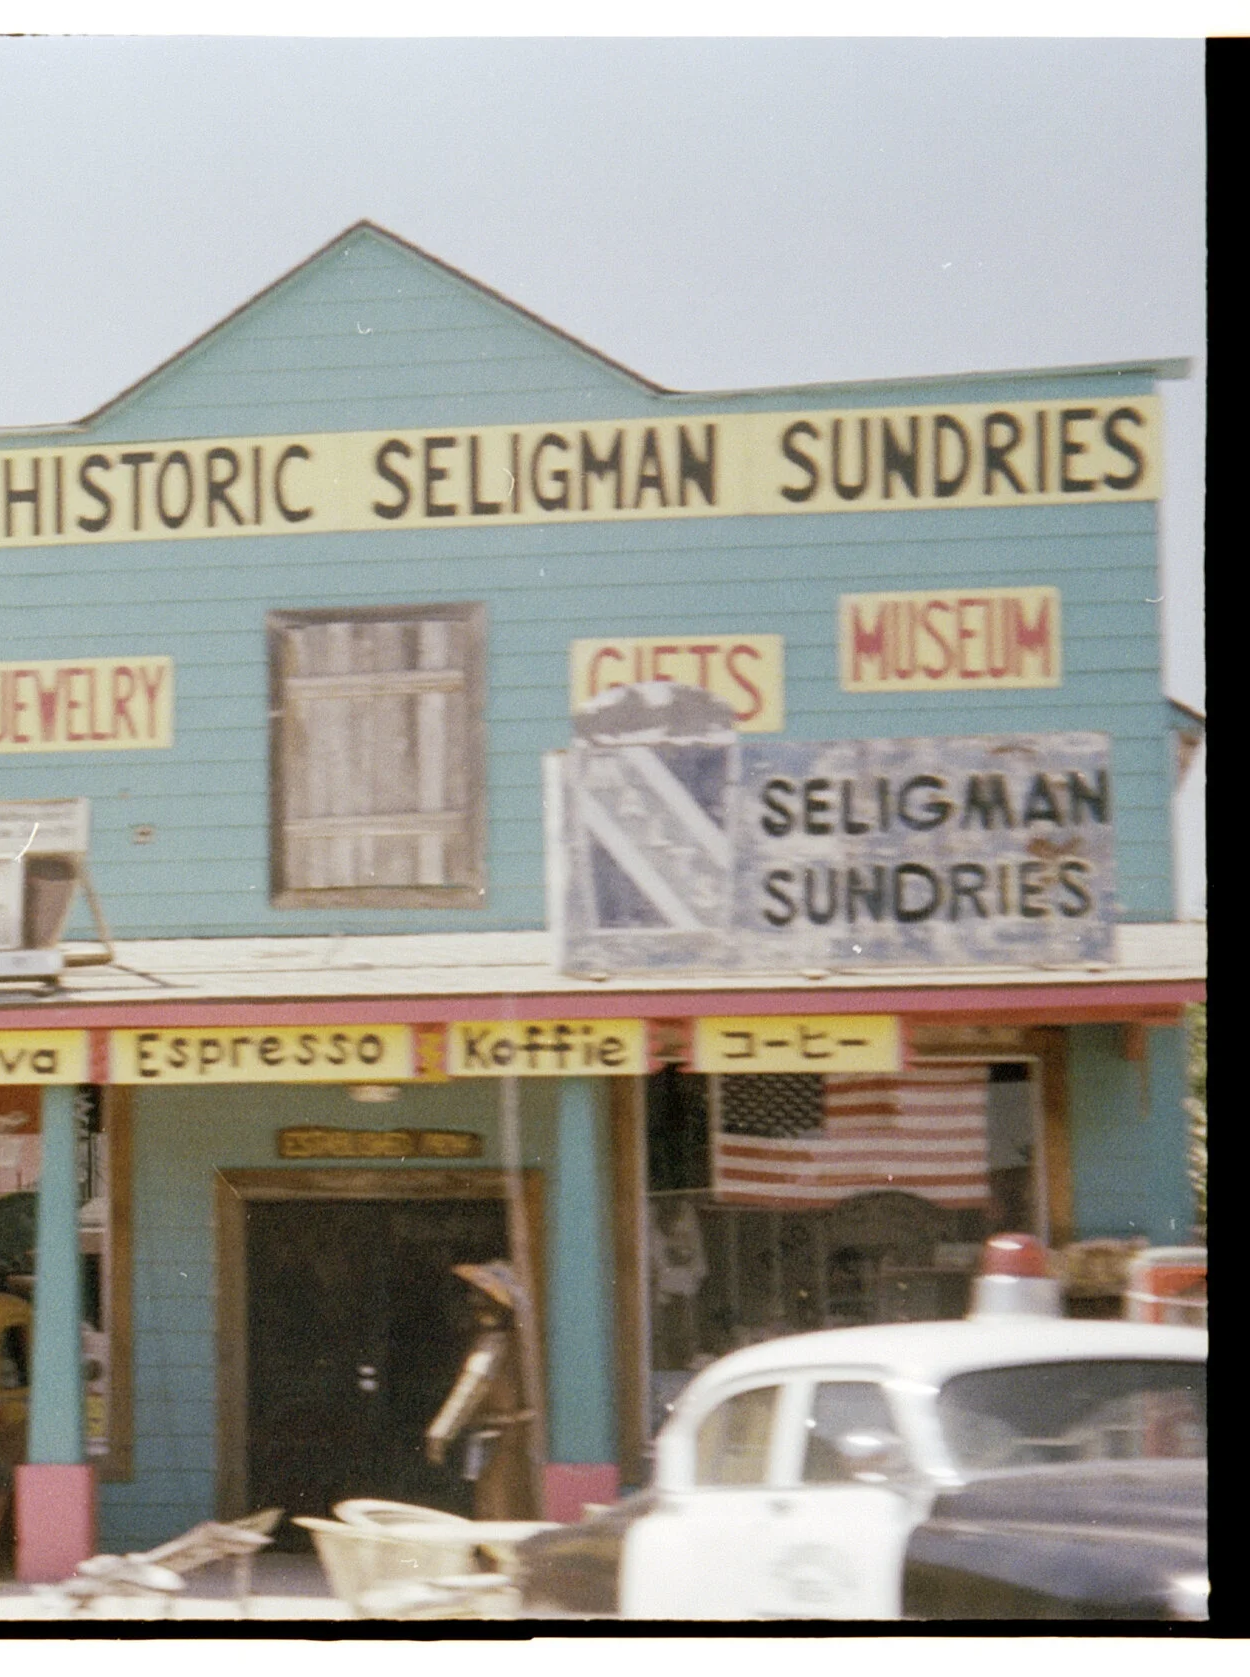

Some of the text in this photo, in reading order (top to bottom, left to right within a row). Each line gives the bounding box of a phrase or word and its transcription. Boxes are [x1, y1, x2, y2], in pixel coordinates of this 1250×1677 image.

[1, 443, 314, 538] HISTORIC
[371, 422, 719, 520] SELIGMAN
[777, 405, 1149, 504] SUNDRIES
[852, 596, 1052, 681] MUSEUM
[760, 769, 1111, 839] SELIGMAN
[760, 861, 1097, 927] SUNDRIES
[135, 1031, 384, 1078] Espresso
[461, 1024, 628, 1069] Koffie
